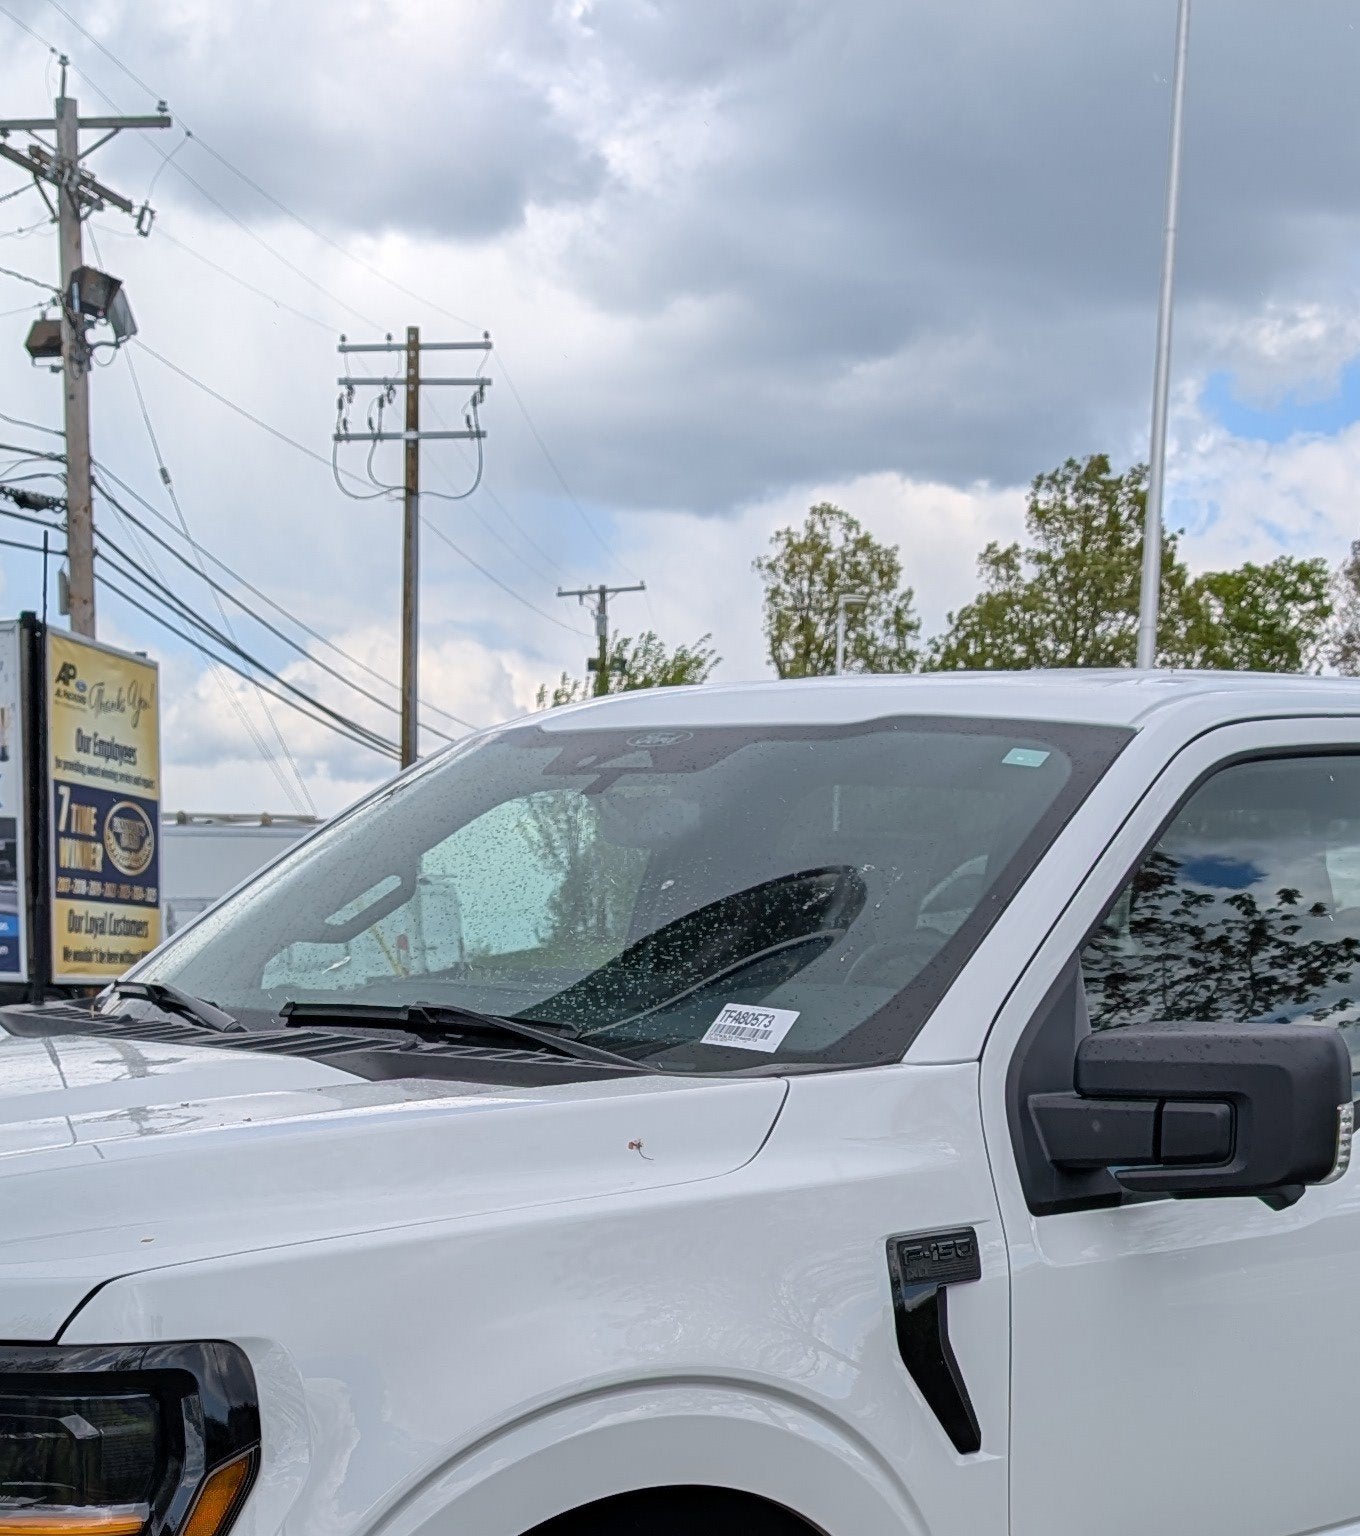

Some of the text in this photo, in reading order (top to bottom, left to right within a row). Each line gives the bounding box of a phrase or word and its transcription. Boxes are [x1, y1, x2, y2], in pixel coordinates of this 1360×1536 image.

[76, 727, 92, 754] Our
[58, 785, 71, 832] 7
[68, 909, 84, 934] Our
[85, 910, 108, 939] Loyal
[720, 1009, 776, 1029] TFA80573
